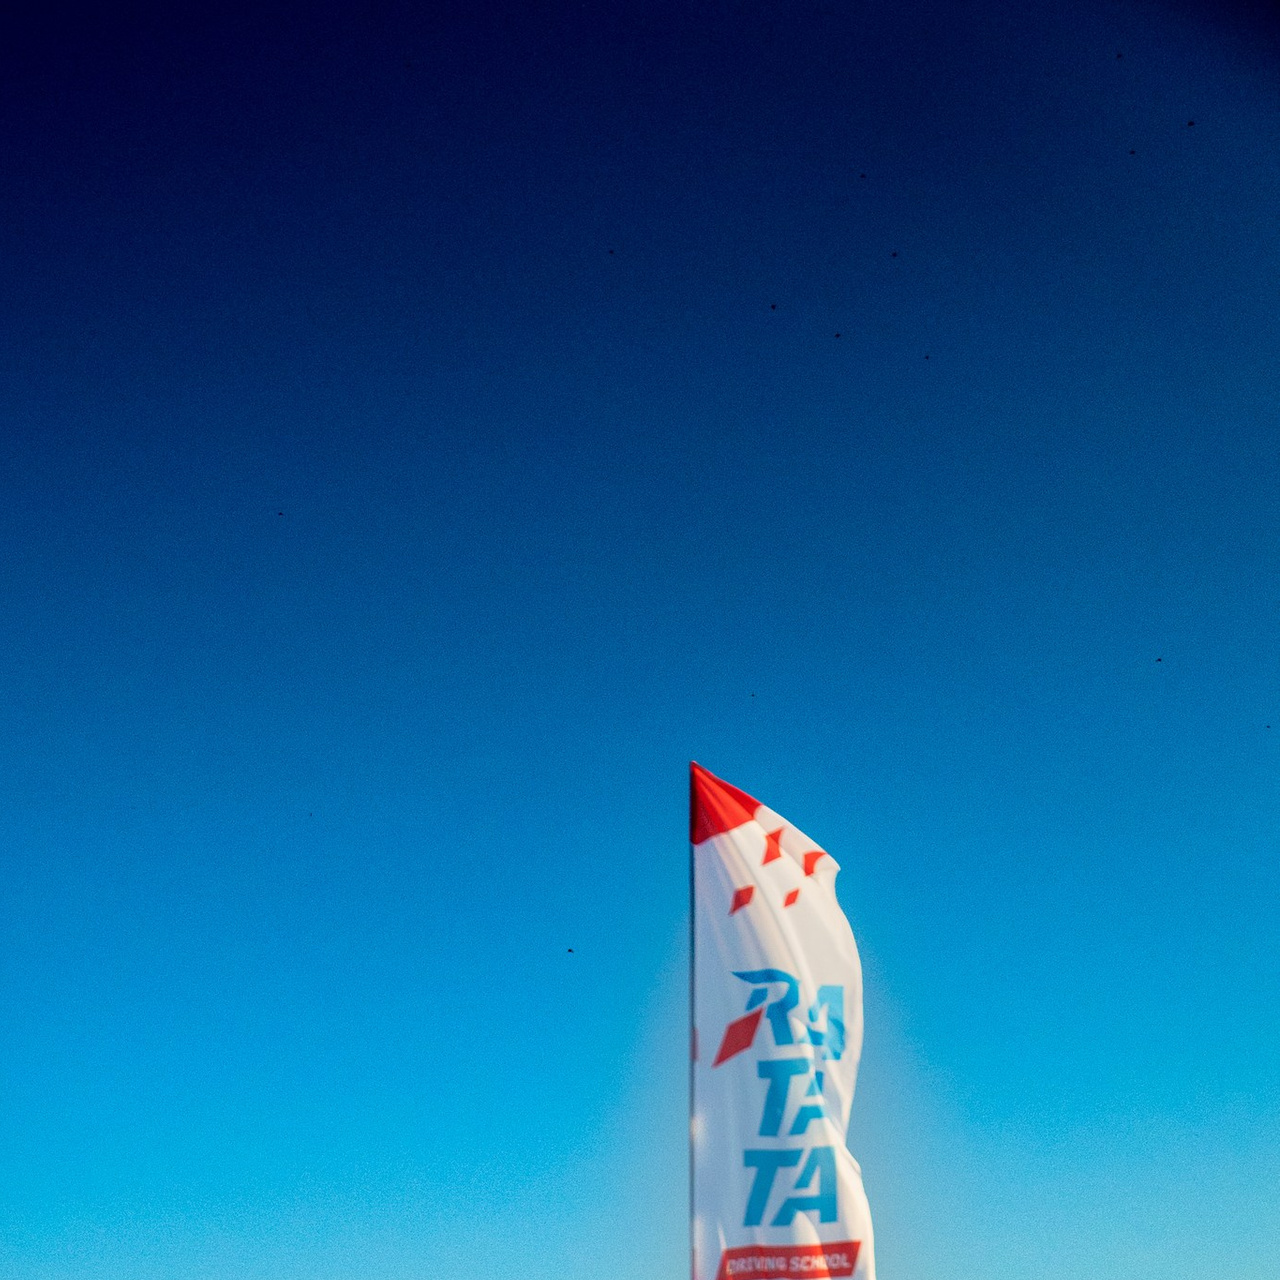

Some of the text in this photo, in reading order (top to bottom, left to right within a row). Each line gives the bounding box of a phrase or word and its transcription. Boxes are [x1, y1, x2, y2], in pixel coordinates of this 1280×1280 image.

[757, 1058, 825, 1138] TA
[743, 1147, 839, 1227] TA
[727, 1252, 852, 1274] DRIVING SCHOOL
